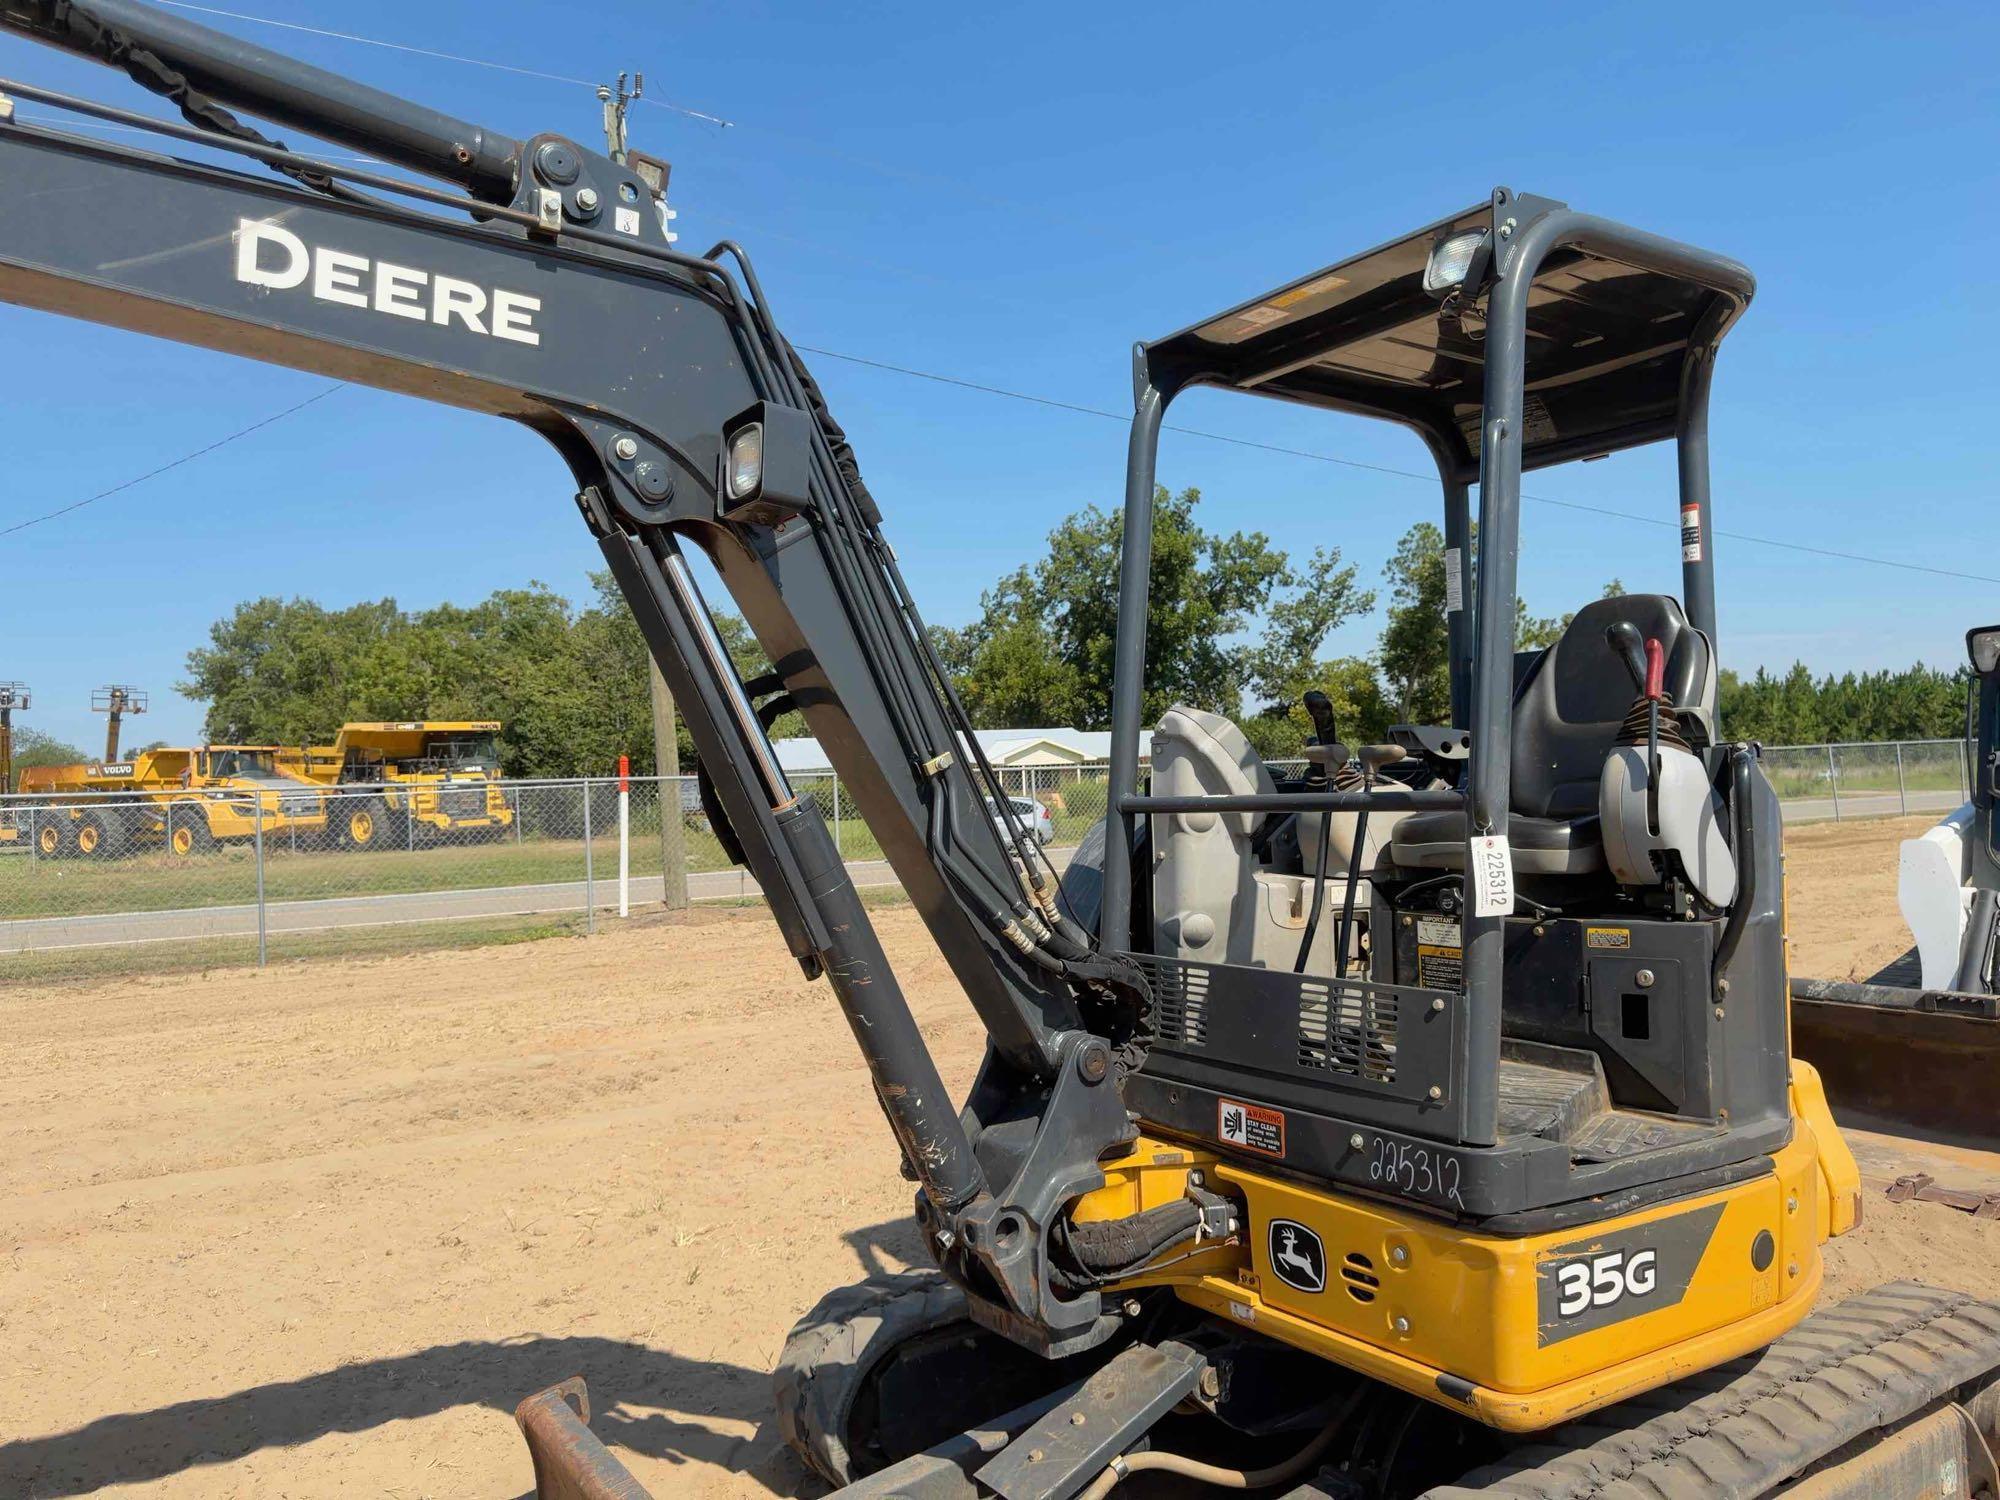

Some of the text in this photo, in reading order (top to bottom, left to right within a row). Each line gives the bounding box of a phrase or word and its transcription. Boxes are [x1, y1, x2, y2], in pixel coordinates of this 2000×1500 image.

[236, 218, 541, 346] DEERE
[103, 765, 132, 775] VOLVO
[1487, 852, 1507, 906] 225312
[1422, 915, 1454, 924] IMPORTANT
[1247, 1119, 1277, 1133] STAY CLEAR
[1252, 1111, 1281, 1124] WARNING
[1370, 1137, 1465, 1210] 225312
[1557, 1250, 1656, 1316] 35G
